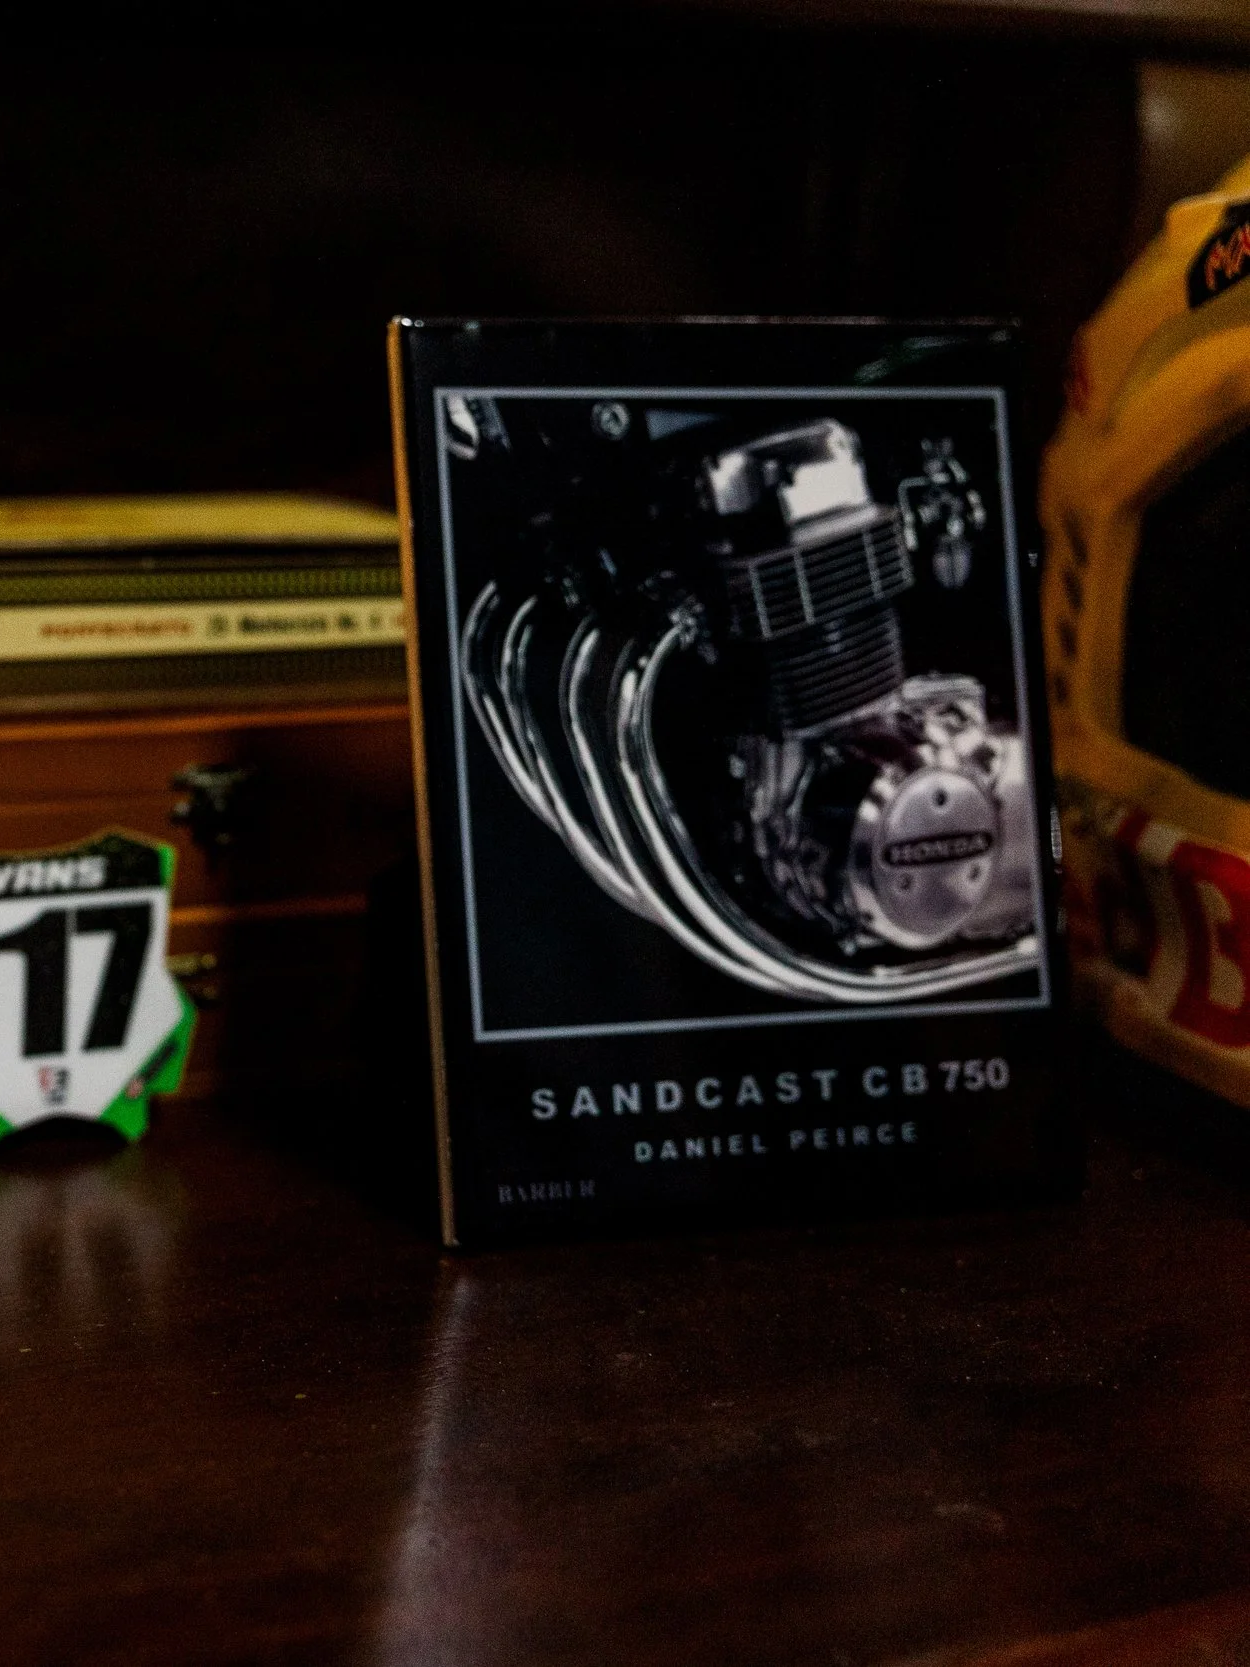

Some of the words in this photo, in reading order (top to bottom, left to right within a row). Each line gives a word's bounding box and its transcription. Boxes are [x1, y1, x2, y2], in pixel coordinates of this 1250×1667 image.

[886, 833, 988, 865] HONDA
[530, 1067, 841, 1122] SANDCAST
[939, 1056, 1012, 1093] 750
[633, 1134, 770, 1163] DANIEL
[788, 1120, 919, 1152] PEIRCE
